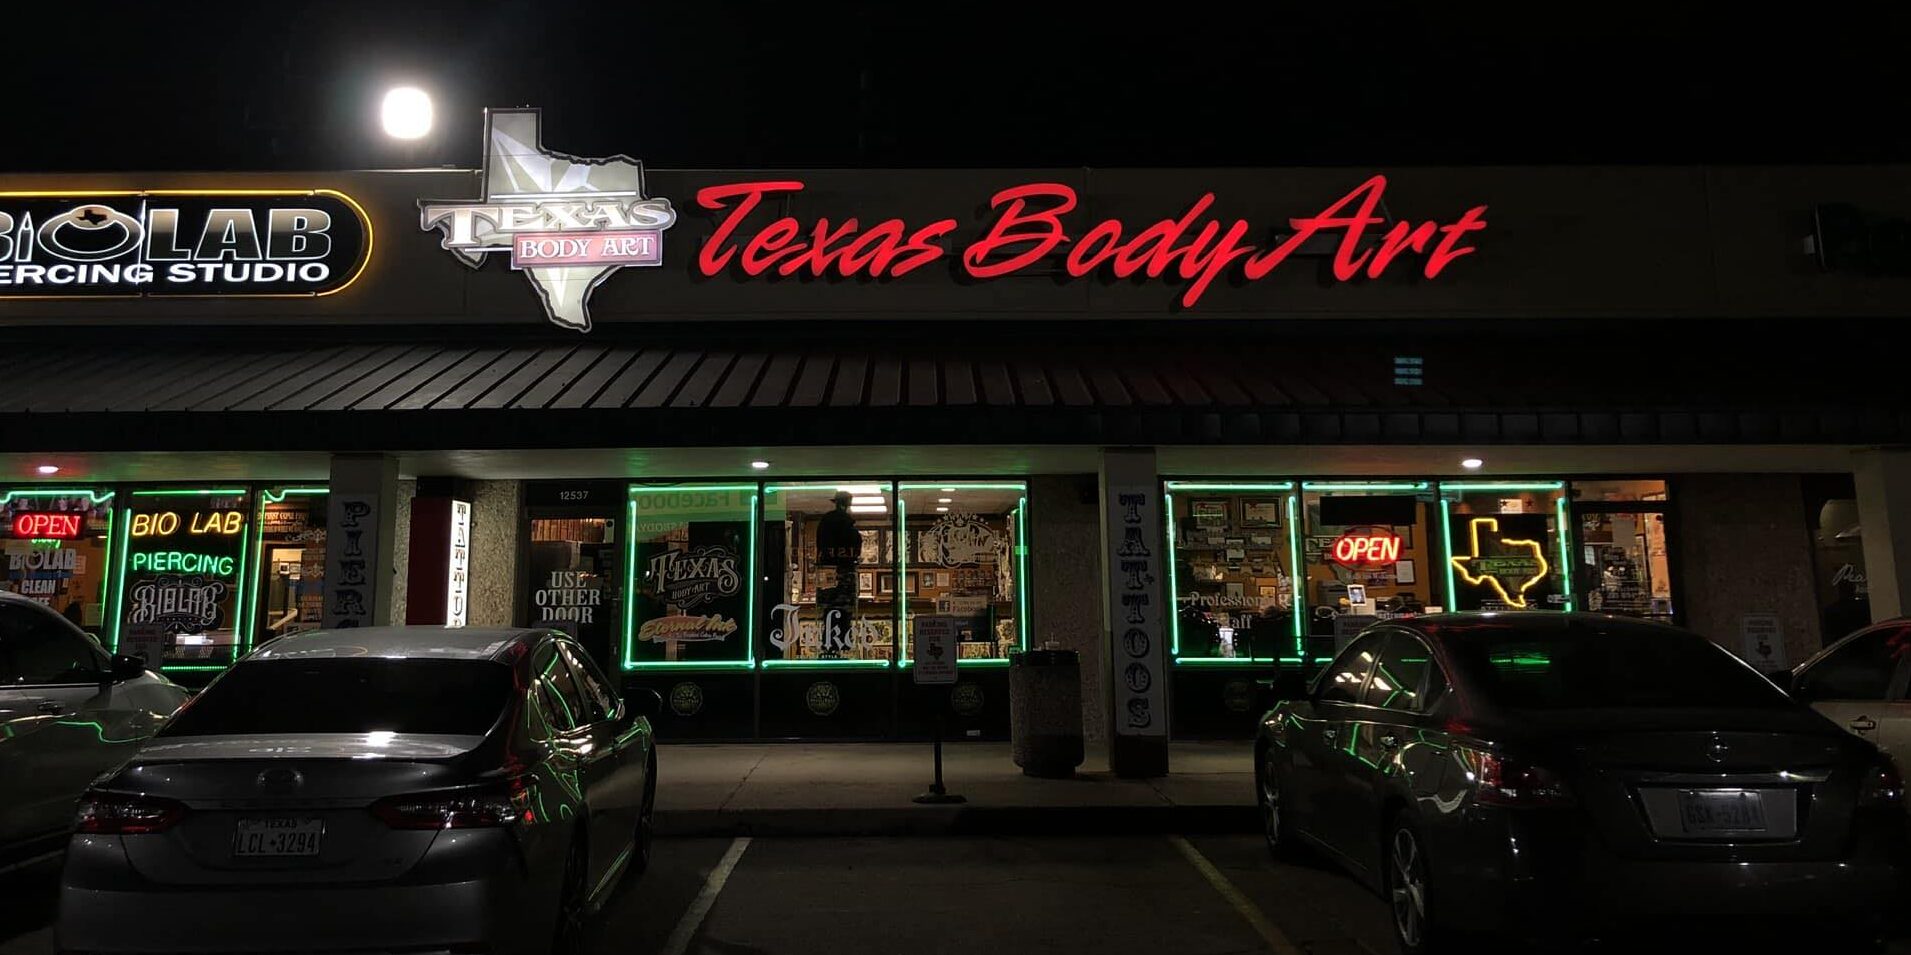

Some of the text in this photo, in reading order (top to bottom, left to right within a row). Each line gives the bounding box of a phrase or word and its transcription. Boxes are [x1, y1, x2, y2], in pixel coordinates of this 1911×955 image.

[0, 204, 331, 262] IOLAB
[426, 204, 672, 246] TEXAS
[519, 237, 655, 258] BODY ART
[696, 174, 1488, 308] Texas Body Art
[167, 262, 330, 283] STUDIO
[560, 491, 588, 500] 12537
[19, 514, 80, 535] OPEN
[131, 511, 179, 536] BIO
[190, 510, 242, 535] LAB
[1336, 537, 1400, 561] OPEN
[132, 552, 234, 576] PIERCING
[646, 551, 741, 595] TEXAS
[21, 580, 57, 594] CLEAN
[551, 570, 587, 588] USE
[535, 589, 601, 606] OTHER
[542, 606, 594, 624] DOOR
[1116, 493, 1151, 729] TATTOOS
